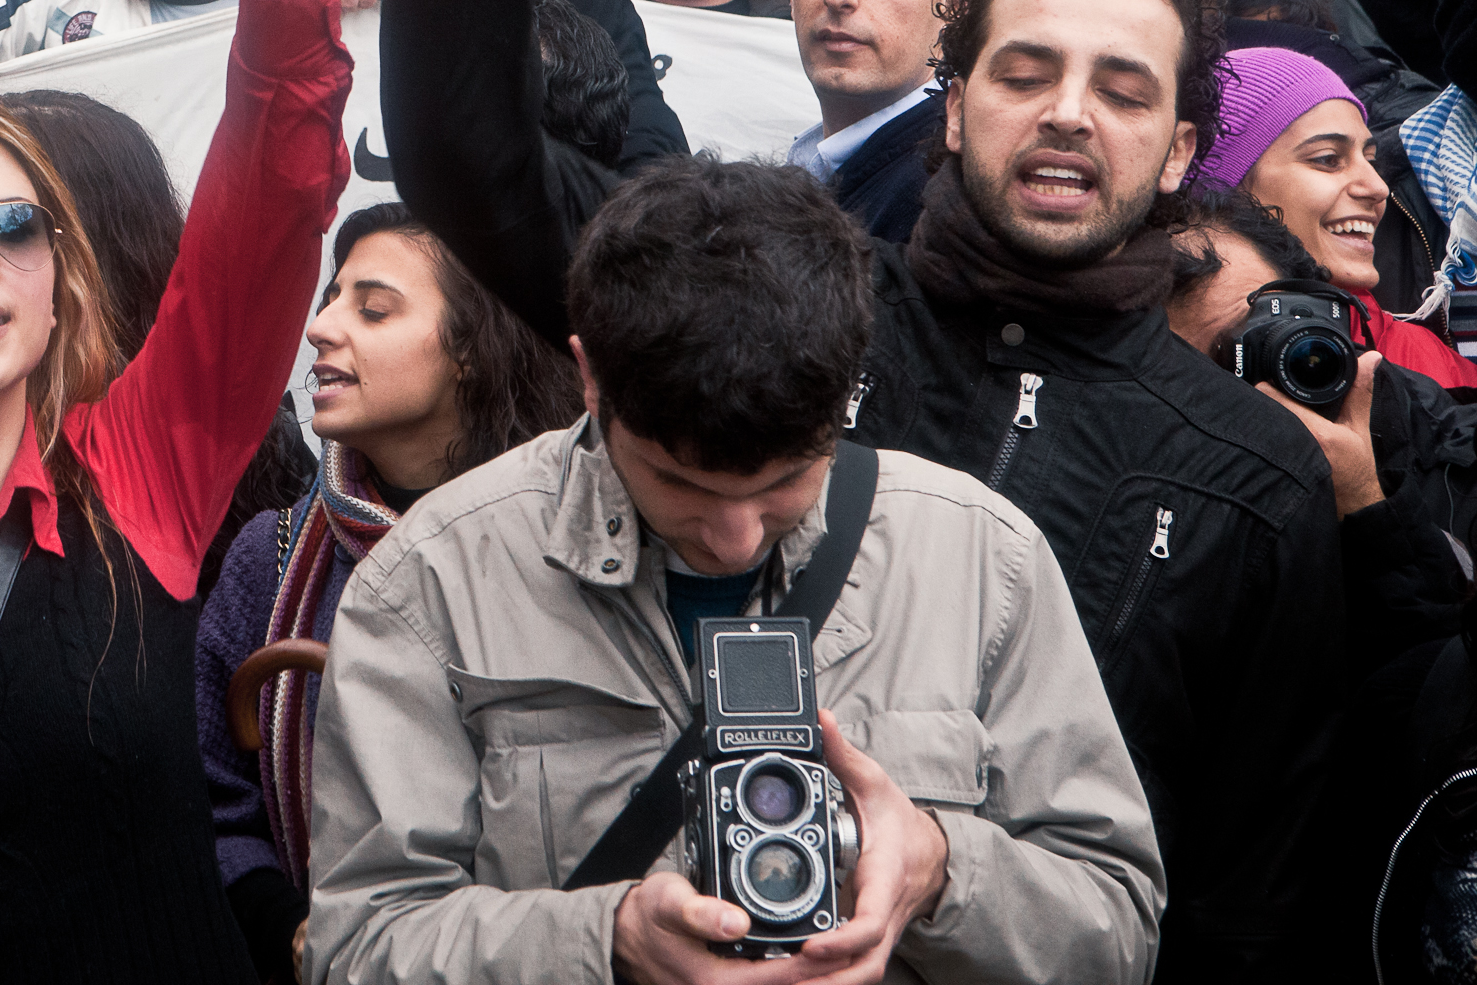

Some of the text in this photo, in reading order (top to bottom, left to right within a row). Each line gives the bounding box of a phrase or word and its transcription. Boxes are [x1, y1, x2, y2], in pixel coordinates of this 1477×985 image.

[1271, 299, 1280, 314] EOS
[1235, 344, 1243, 377] Canon
[724, 730, 806, 746] ROLLEIFLEX
